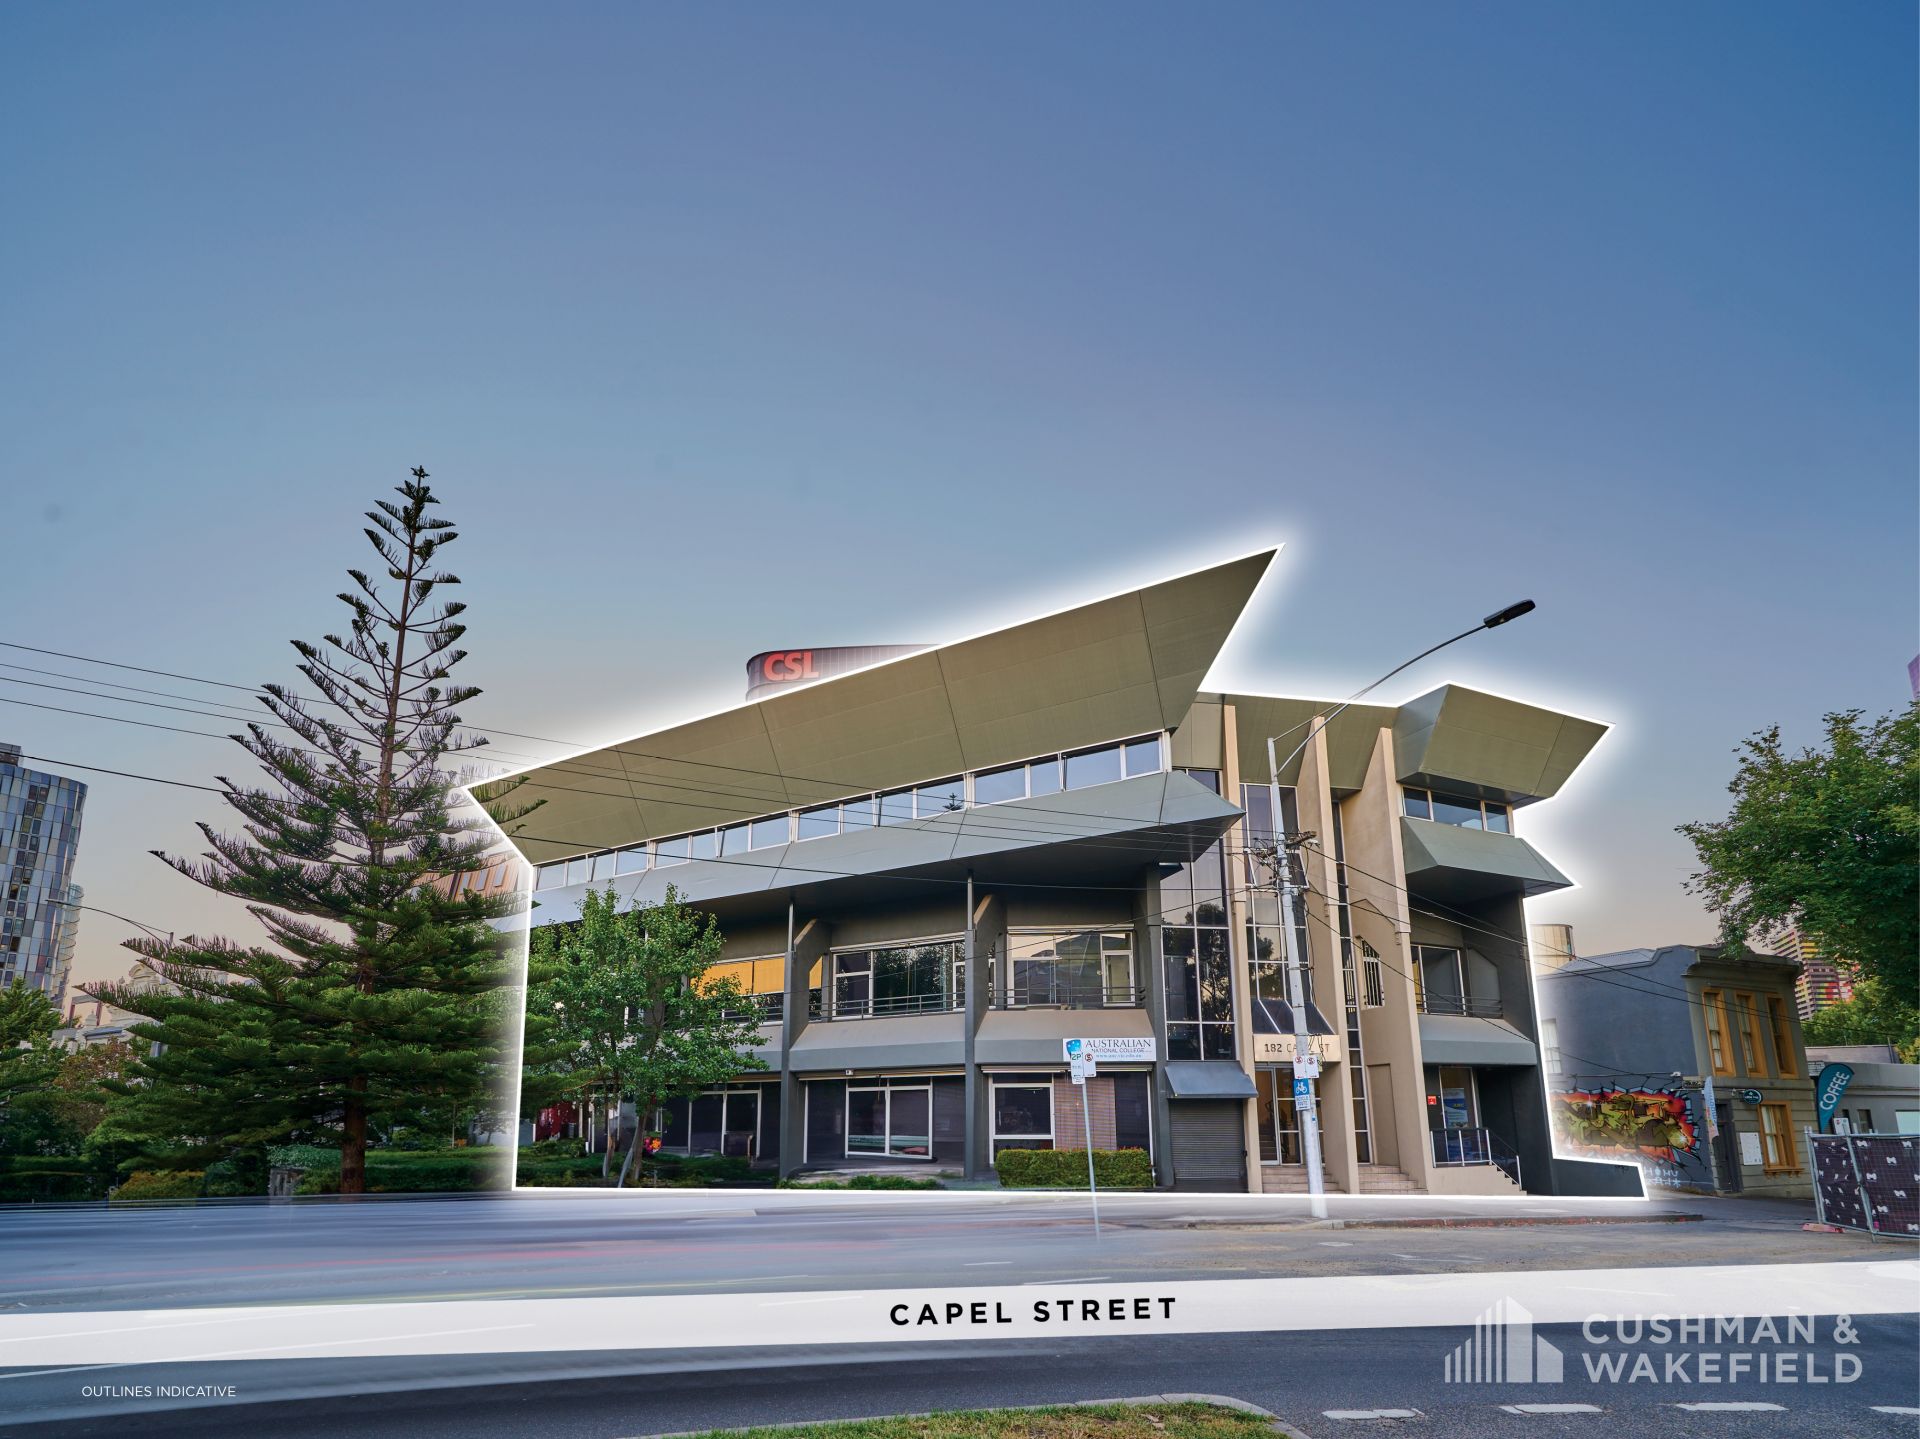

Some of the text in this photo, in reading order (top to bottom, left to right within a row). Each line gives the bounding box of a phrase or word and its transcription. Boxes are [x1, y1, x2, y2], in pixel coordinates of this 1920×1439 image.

[764, 650, 819, 681] CSL
[1085, 1039, 1152, 1048] AUSTRALIAN
[1264, 1043, 1283, 1053] 182
[1071, 1053, 1082, 1061] 2P
[1819, 1071, 1850, 1110] COFFEE
